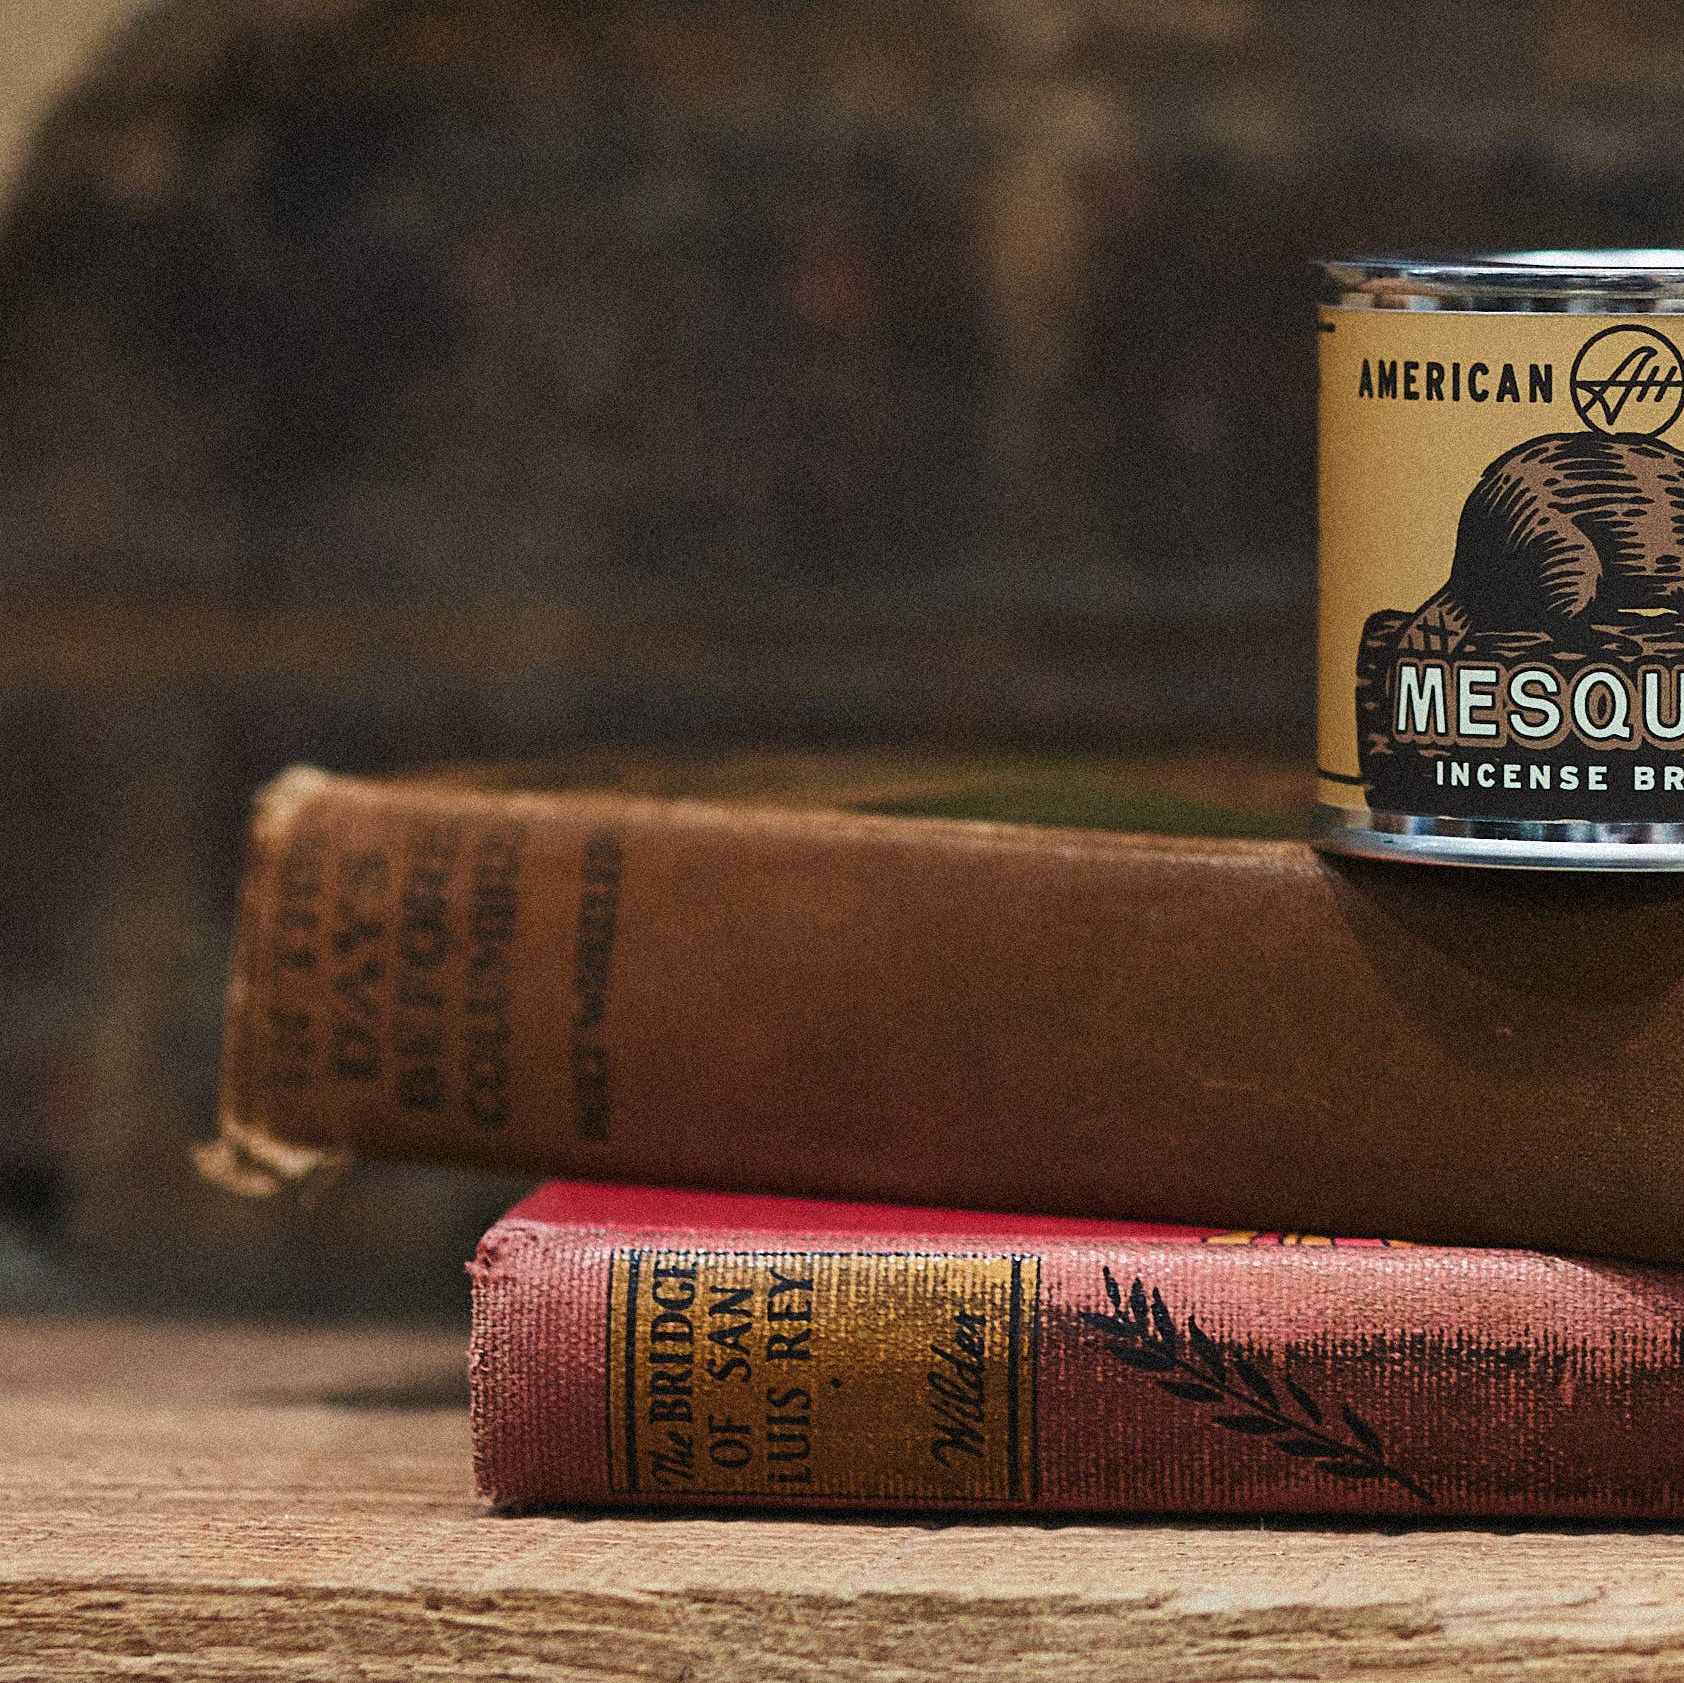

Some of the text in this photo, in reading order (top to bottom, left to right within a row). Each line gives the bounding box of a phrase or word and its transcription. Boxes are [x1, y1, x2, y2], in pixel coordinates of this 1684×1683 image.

[1358, 359, 1554, 404] AMERICAN
[1435, 760, 1608, 791] INCENSE
[648, 1258, 697, 1485] The BRIDGE
[706, 1285, 756, 1469] OF SAN
[766, 1266, 815, 1485] LUIS REY
[927, 1308, 987, 1467] Wilder
